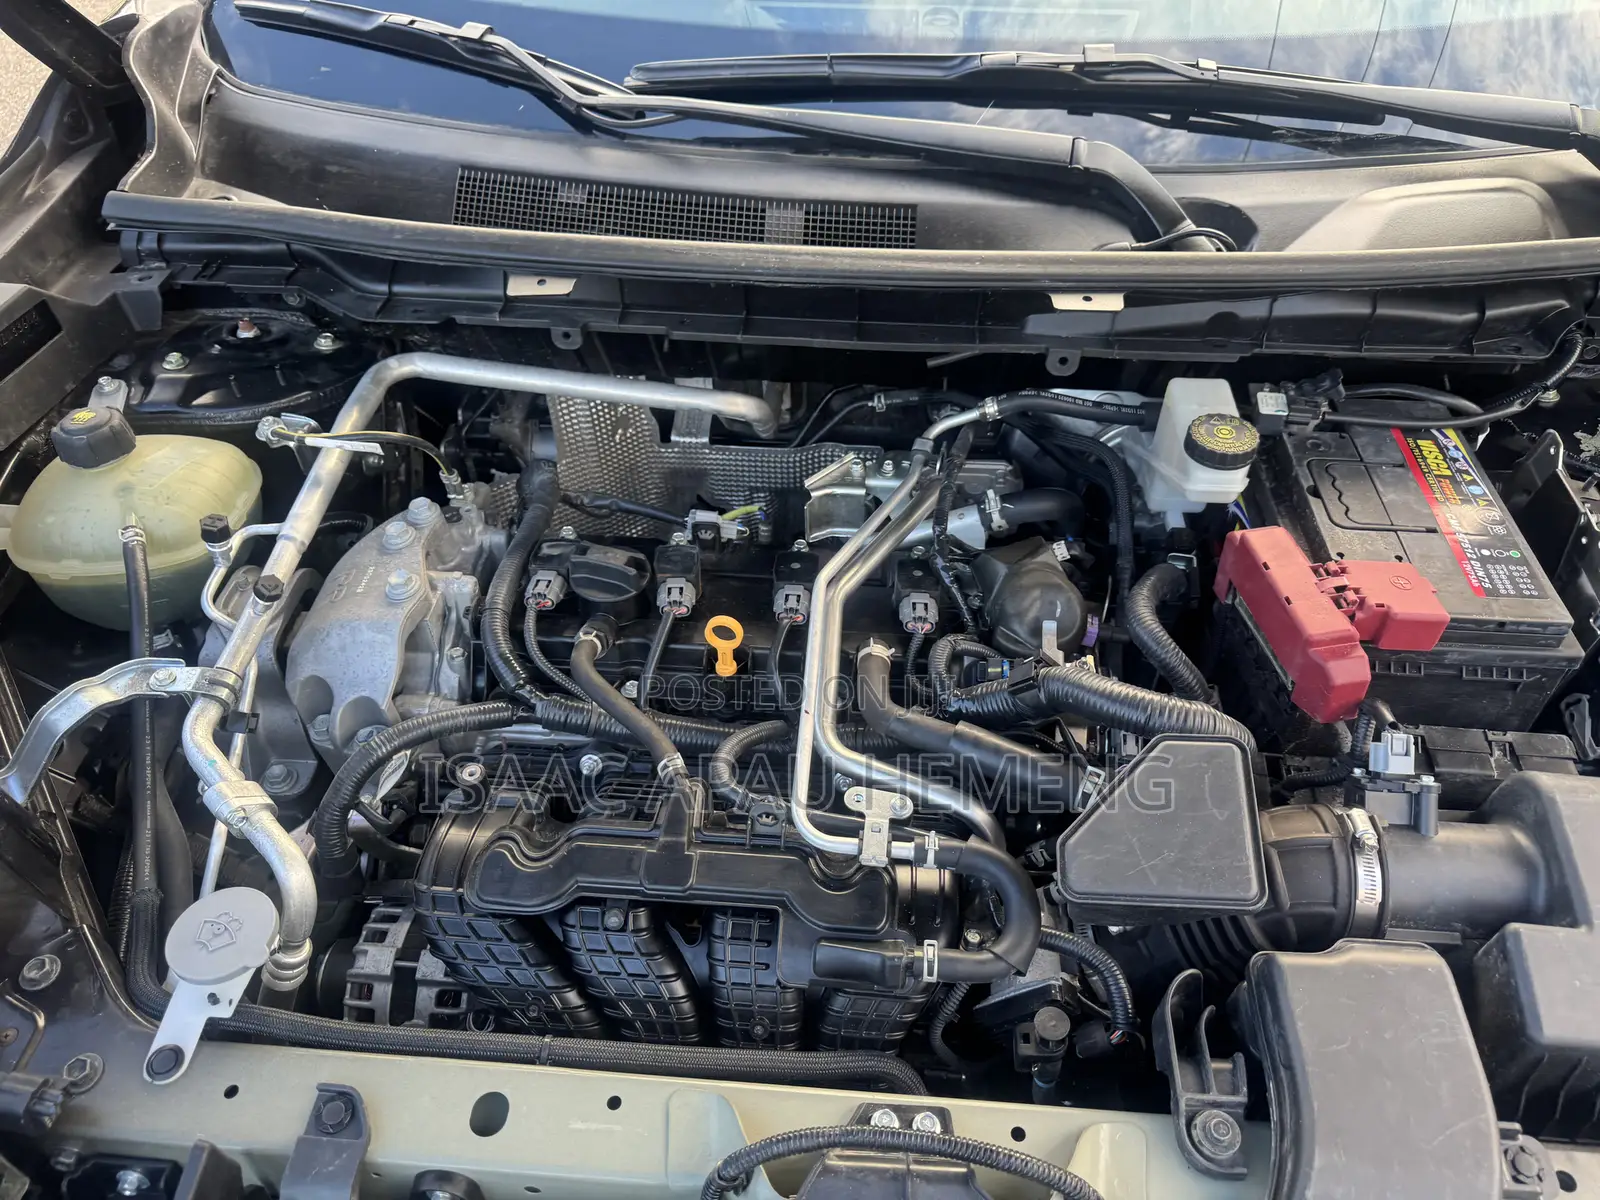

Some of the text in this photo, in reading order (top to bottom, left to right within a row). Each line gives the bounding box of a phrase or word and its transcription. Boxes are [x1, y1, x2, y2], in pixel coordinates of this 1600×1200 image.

[1416, 439, 1453, 477] VISCA
[1436, 478, 1462, 505] POWER
[1424, 473, 1445, 502] CERTIFIED
[1455, 531, 1477, 559] 57512
[1469, 560, 1493, 589] DIN75
